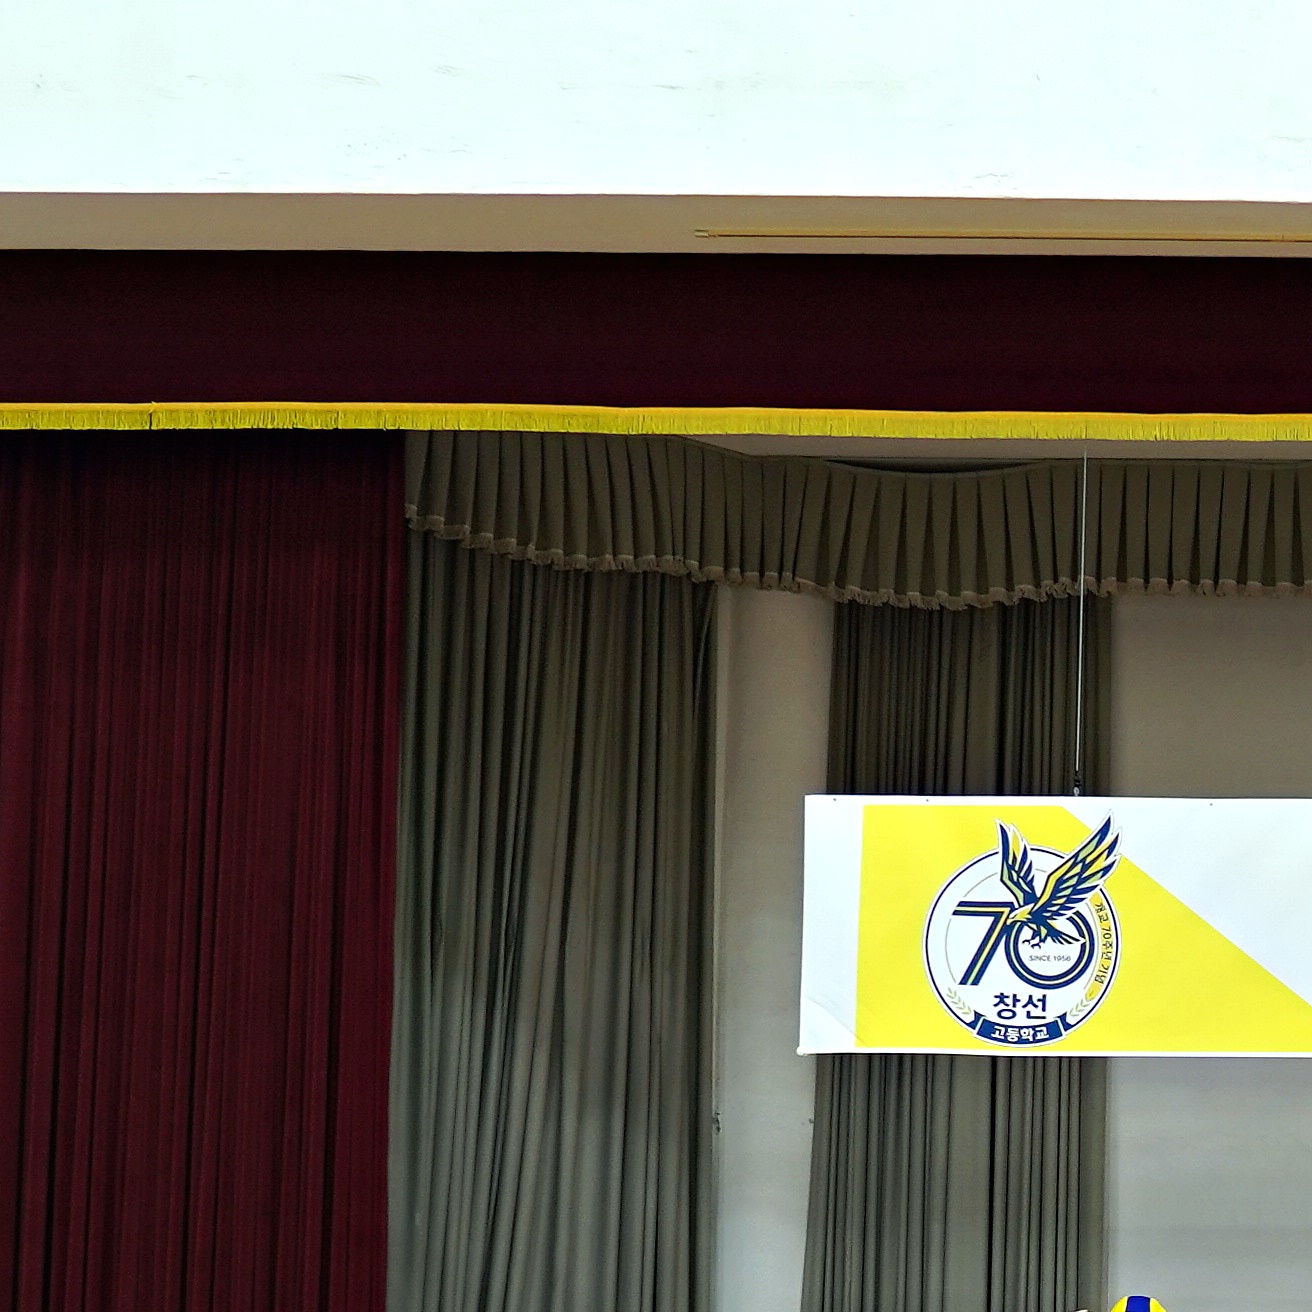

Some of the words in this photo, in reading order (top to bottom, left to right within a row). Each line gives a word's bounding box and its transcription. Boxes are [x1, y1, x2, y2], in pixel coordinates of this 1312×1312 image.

[1095, 902, 1109, 923] 개교
[952, 901, 1095, 989] 70
[1101, 926, 1113, 960] 70주년
[1095, 964, 1109, 984] 기념
[993, 992, 1047, 1020] 창선
[990, 1026, 1050, 1042] 고등학교
